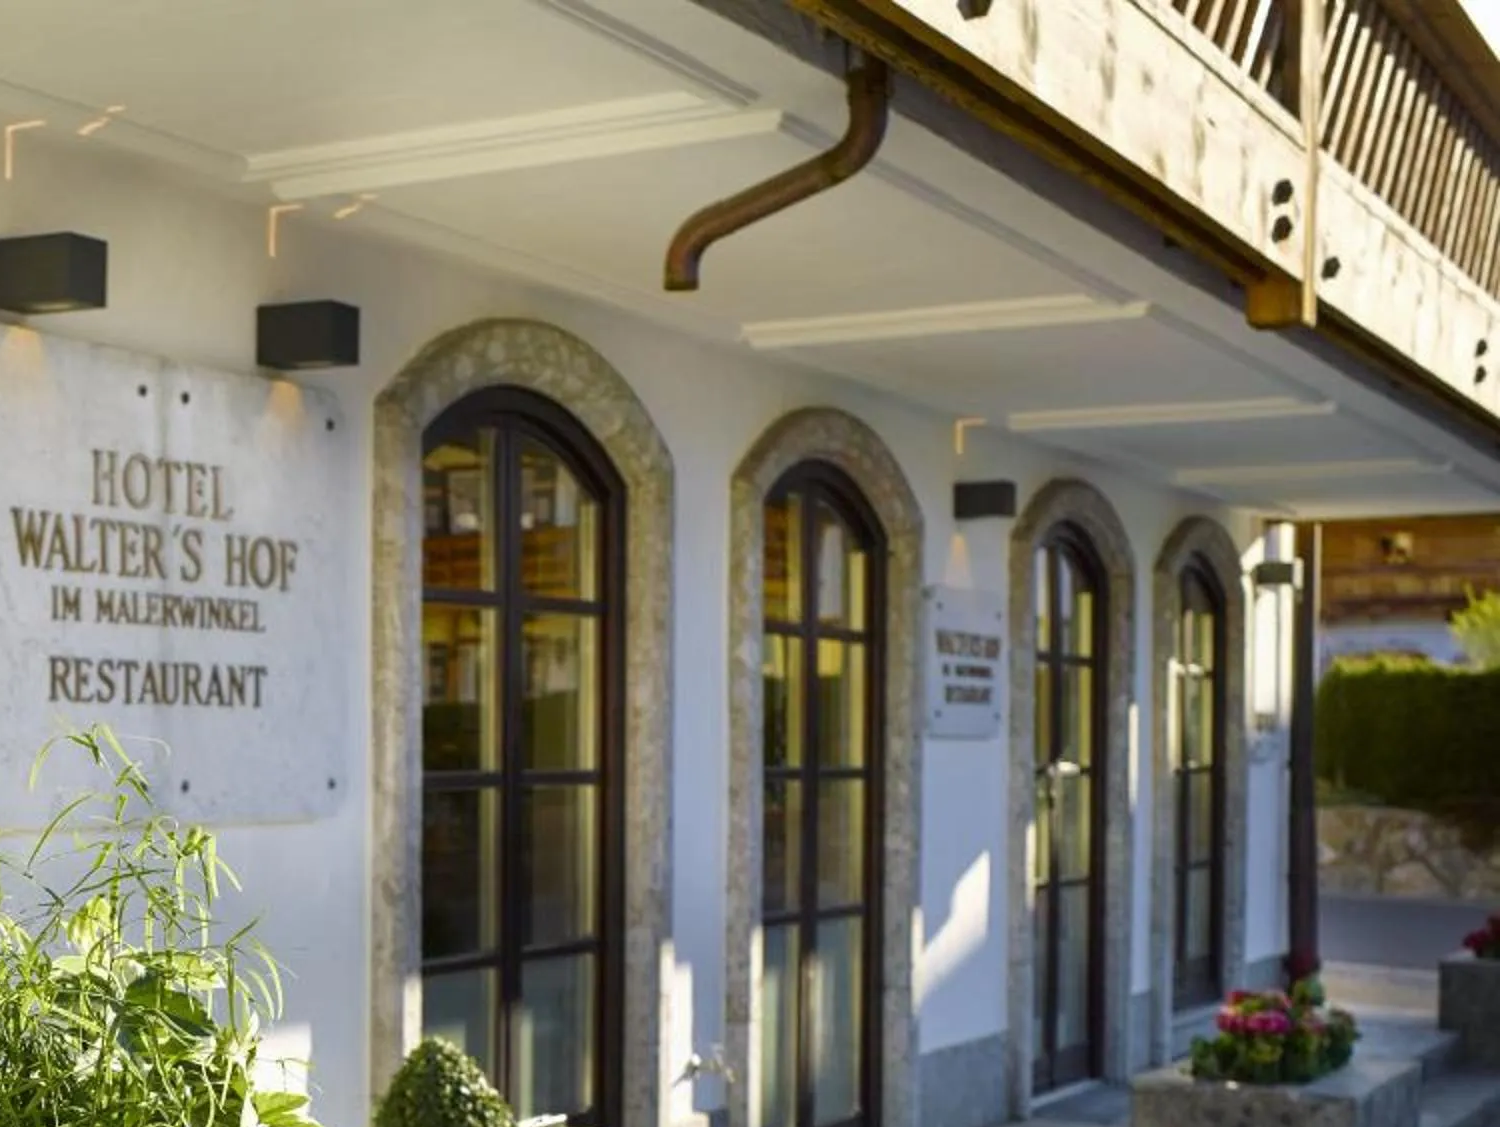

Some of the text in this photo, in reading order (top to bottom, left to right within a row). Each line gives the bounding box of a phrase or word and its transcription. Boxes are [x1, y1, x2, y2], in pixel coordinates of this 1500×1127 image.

[91, 449, 234, 521] HOTEL
[10, 505, 298, 592] WALTER'S HOF
[51, 585, 266, 633] IM MALERWINKEL
[48, 655, 267, 709] RESTAURANT
